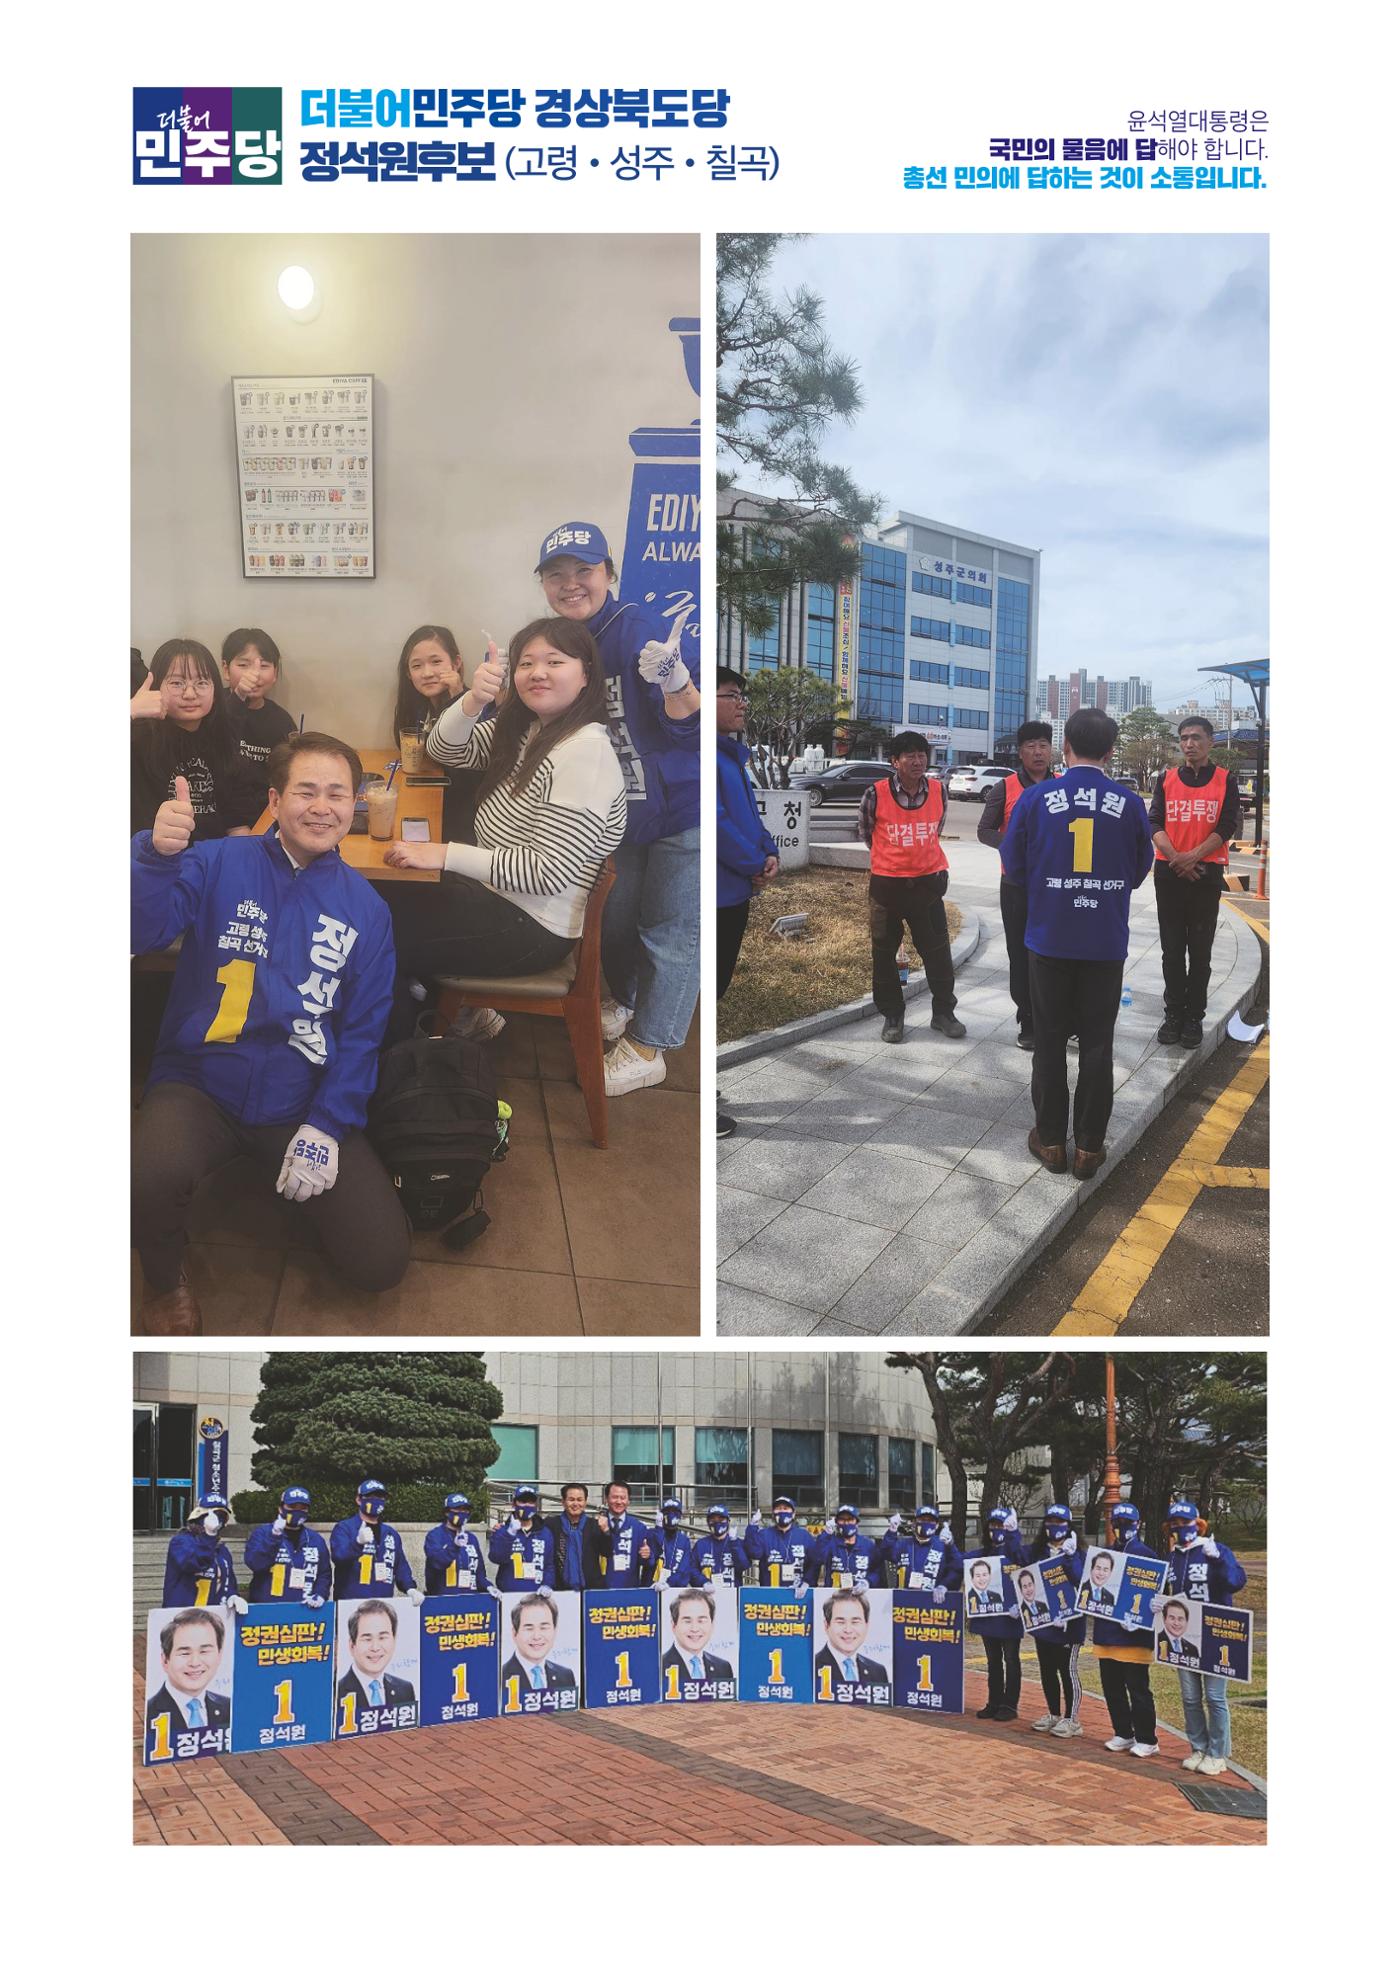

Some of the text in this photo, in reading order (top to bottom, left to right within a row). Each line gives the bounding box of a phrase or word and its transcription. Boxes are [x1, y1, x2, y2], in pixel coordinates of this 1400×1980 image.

[546, 531, 591, 554] 민주당
[934, 560, 987, 584] 성주군의회
[1044, 788, 1126, 819] 정석원
[1166, 800, 1218, 823] 단결투쟁
[1068, 818, 1094, 873] 1
[1074, 899, 1098, 908] 민주당
[204, 959, 256, 1043] 1
[358, 1554, 373, 1585] 1
[511, 1552, 524, 1579] 1
[768, 1563, 780, 1588] 1
[270, 1563, 286, 1597] 1
[970, 1596, 979, 1614] 1
[1057, 1590, 1068, 1609] 1
[1078, 1590, 1090, 1610] 1
[1130, 1593, 1142, 1614] 1
[425, 1612, 491, 1634] 정권심판!
[589, 1606, 651, 1624] 정권심판!
[744, 1604, 807, 1620] 정권심판!
[893, 1607, 956, 1626] 정권심판!
[1024, 1609, 1033, 1628] 1
[240, 1622, 325, 1646] 정권심판!
[602, 1624, 656, 1640] 민생회복!
[756, 1622, 811, 1637] 민생회복!
[904, 1626, 961, 1644] 민생회복!
[439, 1632, 496, 1651] 민생회복!
[258, 1645, 330, 1666] 민생회복!
[1159, 1640, 1200, 1668] 1 정석원
[1219, 1645, 1230, 1667] 1
[615, 1651, 632, 1688] 1
[768, 1648, 785, 1684] 1
[917, 1654, 934, 1692] 1
[452, 1663, 470, 1703] 1
[505, 1675, 576, 1713] 1 정석원
[665, 1665, 735, 1700] 1 정석원
[758, 1685, 793, 1699] 정석원
[818, 1665, 889, 1704] 1 정석원
[273, 1679, 295, 1725] 1
[606, 1688, 641, 1703] 정석원
[907, 1692, 942, 1707] 정석원
[339, 1692, 416, 1735] 1 정석원
[441, 1703, 479, 1720] 정석원
[150, 1711, 174, 1761] 1
[259, 1724, 305, 1744] 정석원
